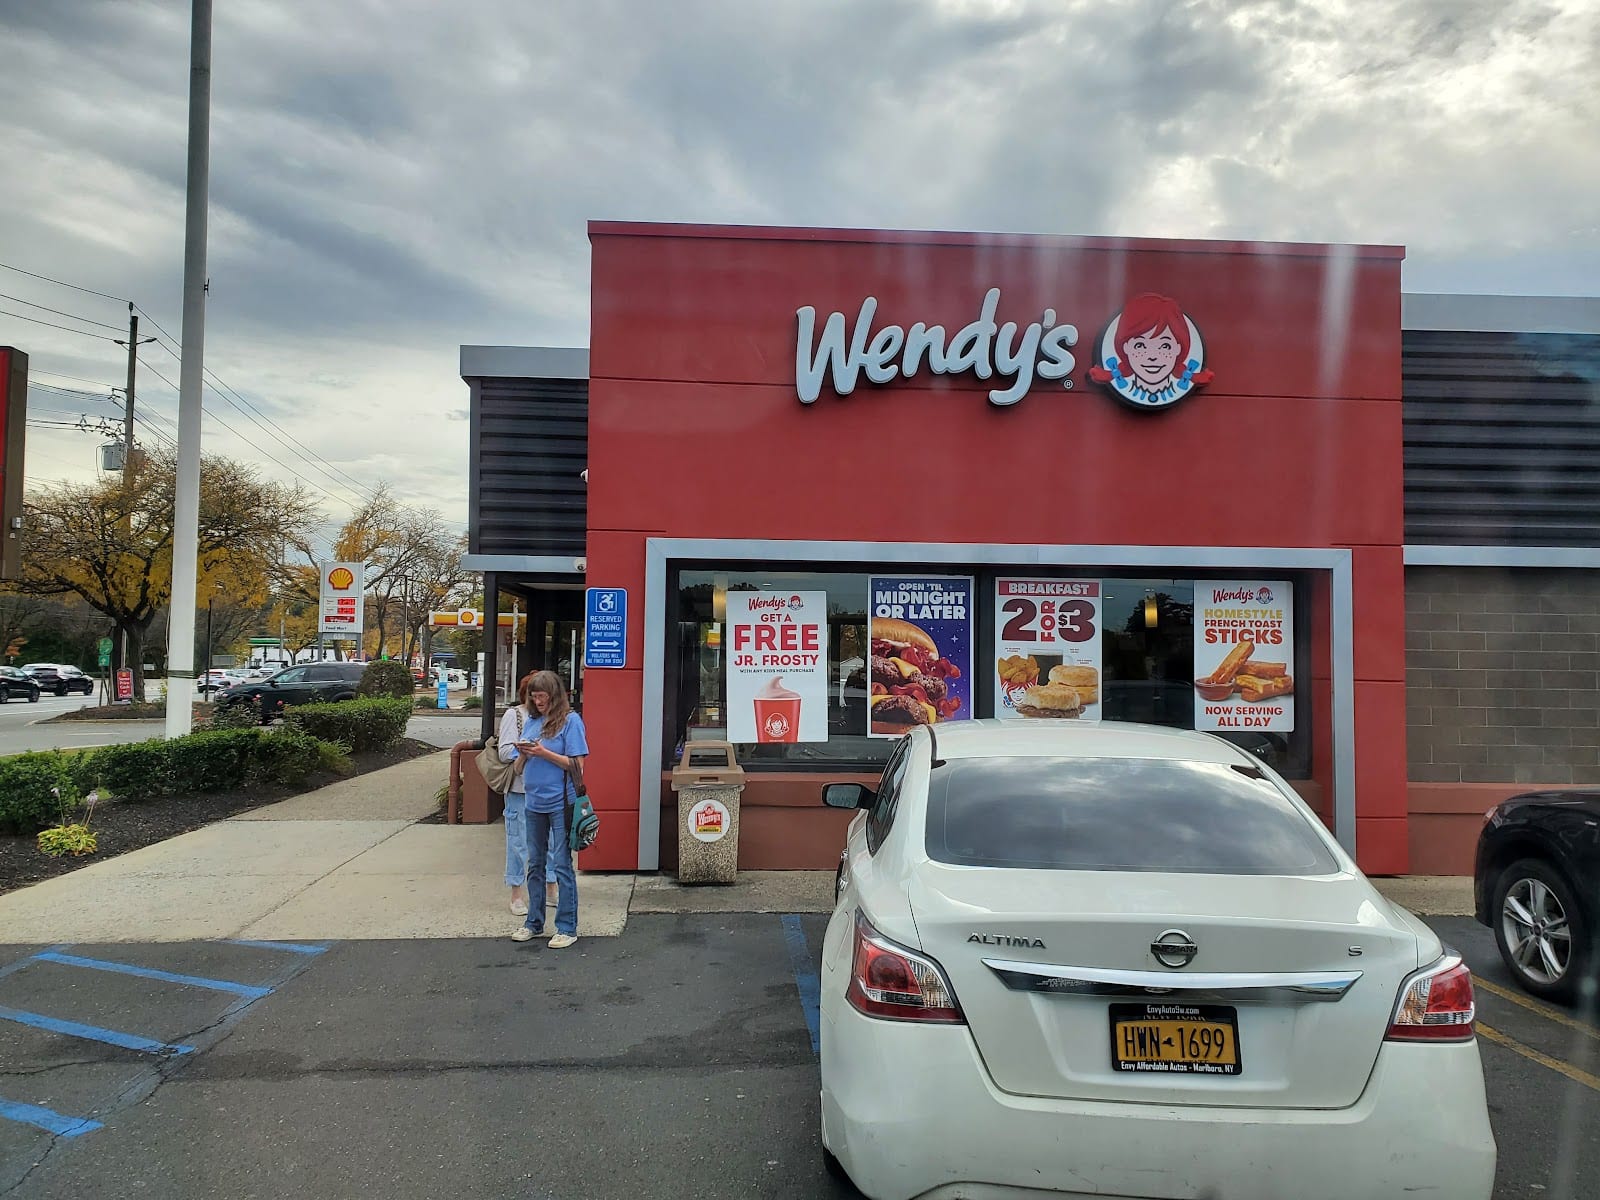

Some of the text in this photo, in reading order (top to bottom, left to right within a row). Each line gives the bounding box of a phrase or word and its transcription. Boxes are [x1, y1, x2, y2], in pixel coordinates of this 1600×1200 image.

[796, 287, 1079, 406] Wendy's
[898, 582, 944, 591] OPEN 'TIL
[1008, 582, 1090, 594] BREAKFAST
[876, 590, 966, 604] MIDNIGHT
[1213, 587, 1254, 604] Wendy's
[748, 596, 786, 611] Wendy's
[761, 614, 792, 622] GET A
[876, 604, 966, 620] OR LATER
[1204, 608, 1283, 618] HOMESTYLE
[1002, 598, 1096, 642] 2 FOR $3
[1205, 620, 1246, 628] FRENCH
[734, 624, 819, 651] FREE
[1205, 628, 1283, 644] STICKS
[734, 654, 819, 666] JR. FROSTY
[1206, 707, 1283, 715] NOW SERVING
[1218, 717, 1271, 727] ALL DAY
[967, 932, 1046, 949] ALTIMA
[1348, 945, 1362, 956] S
[1123, 1026, 1224, 1058] HWN 1699
[1121, 1061, 1136, 1071] Envy
[1137, 1062, 1168, 1070] Affordable
[1170, 1062, 1187, 1071] Autos
